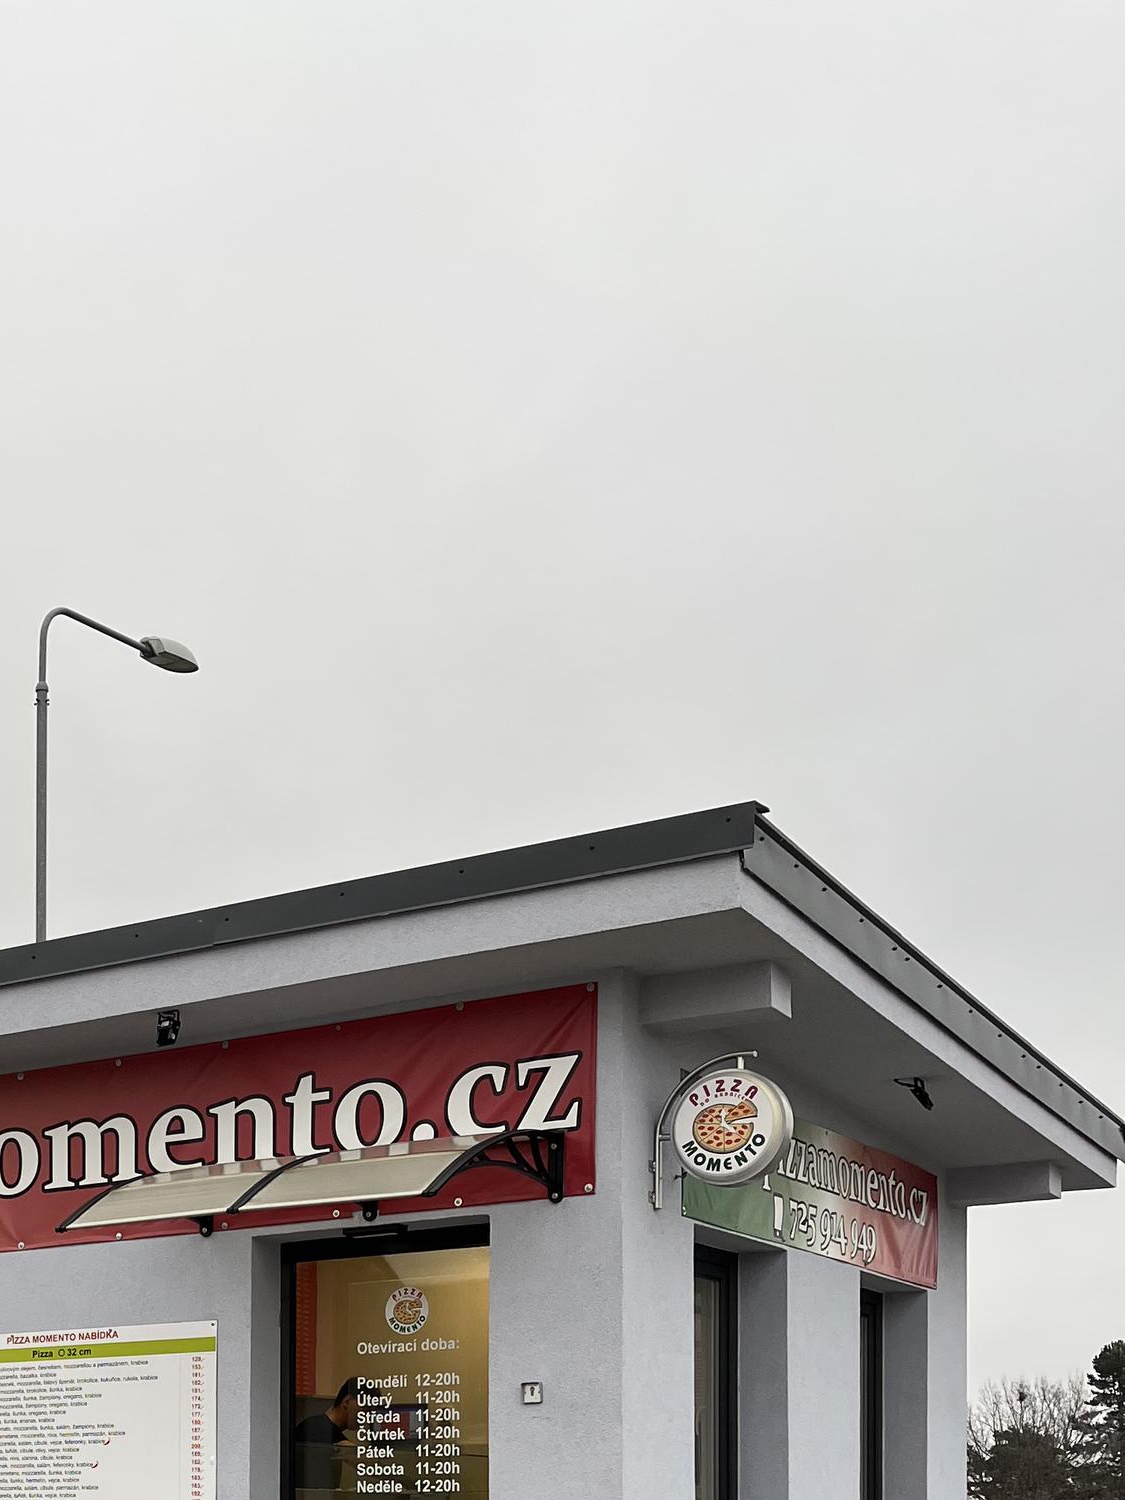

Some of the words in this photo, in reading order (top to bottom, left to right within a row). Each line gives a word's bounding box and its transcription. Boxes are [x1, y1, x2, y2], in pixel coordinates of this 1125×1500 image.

[689, 1079, 759, 1107] PIZZA
[682, 1133, 766, 1172] MOMENTO
[789, 1198, 817, 1246] 725
[820, 1209, 848, 1255] 914
[851, 1219, 876, 1264] 949
[392, 1288, 423, 1302] PIZZA
[389, 1315, 426, 1333] MOMENTO
[6, 1334, 30, 1345] PIZZA
[32, 1333, 76, 1344] MOMENTO
[78, 1328, 119, 1341] NABÍDKA
[32, 1350, 53, 1359] Pizza
[67, 1348, 77, 1357] 32
[357, 1339, 417, 1355] Otevírací
[421, 1338, 460, 1351] doba:
[357, 1374, 408, 1390] Pondělí
[415, 1372, 460, 1387] 12-20h
[357, 1391, 393, 1409] Úterý
[415, 1390, 460, 1404] 11-20h
[357, 1410, 401, 1424] Středa
[415, 1408, 460, 1422] 11-20h
[357, 1425, 405, 1441] Čtvrtek
[415, 1426, 460, 1440] 11-20h
[357, 1445, 395, 1459] Pátek
[415, 1443, 460, 1457] 11-20h
[357, 1463, 404, 1476] Sobota
[415, 1461, 460, 1475] 11-20h
[357, 1480, 403, 1494] Neděle
[415, 1479, 460, 1493] 12-20h
